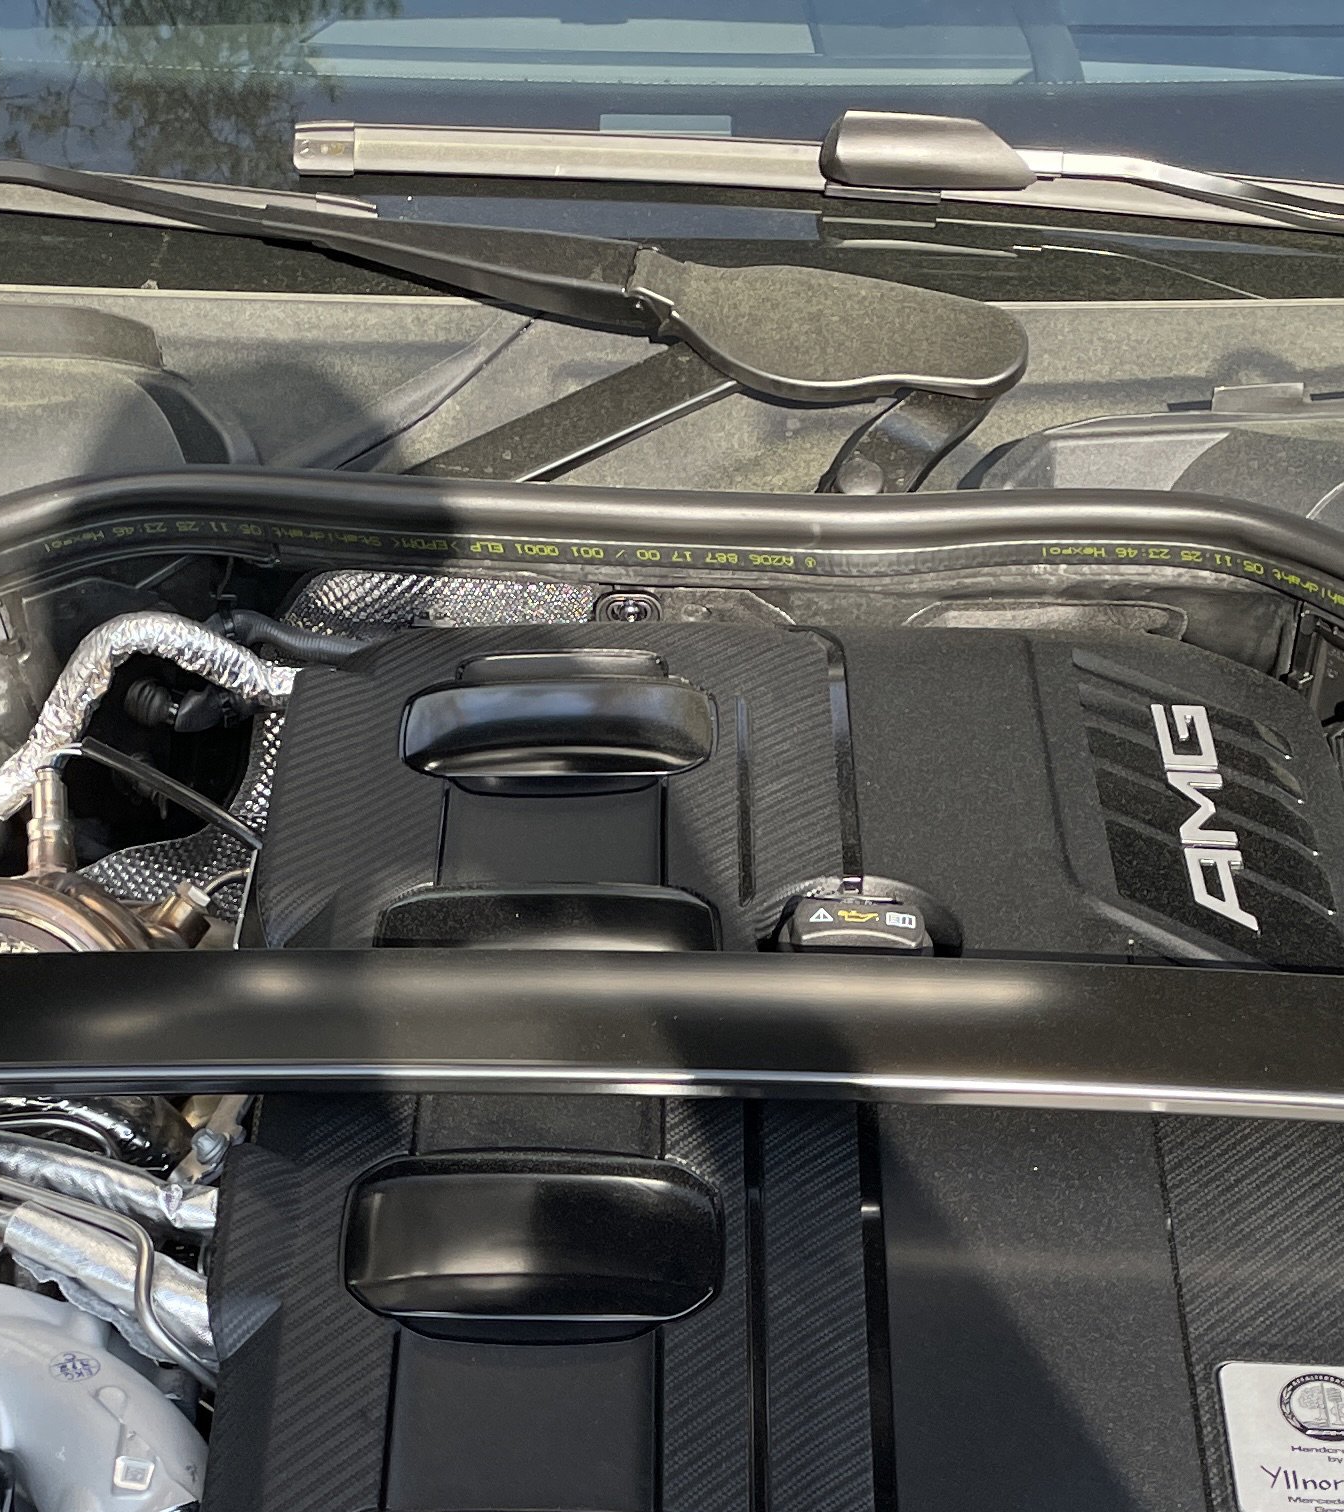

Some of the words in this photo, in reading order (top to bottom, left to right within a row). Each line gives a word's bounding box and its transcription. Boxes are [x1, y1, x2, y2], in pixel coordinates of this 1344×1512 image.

[673, 548, 694, 563] 17
[1115, 545, 1172, 561] 23:46
[1151, 703, 1260, 932] AMG
[1327, 1456, 1343, 1464] by
